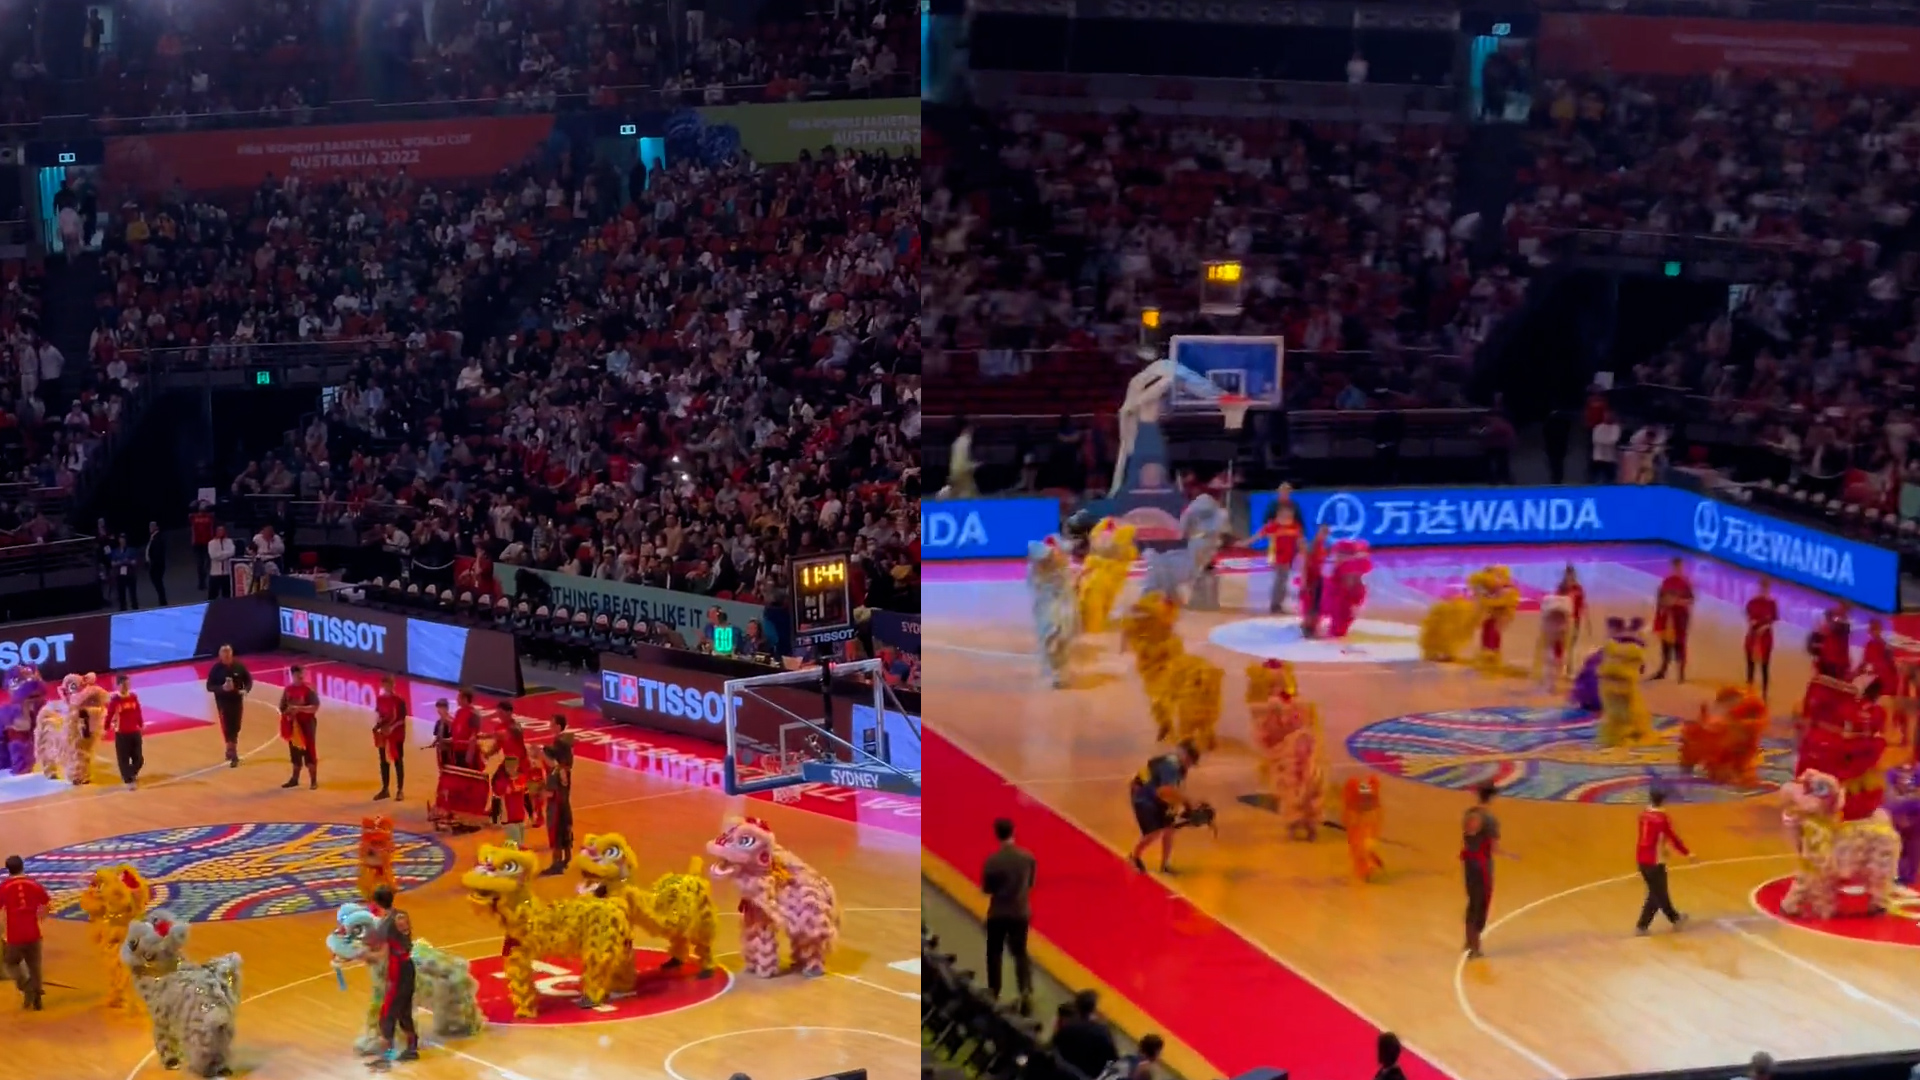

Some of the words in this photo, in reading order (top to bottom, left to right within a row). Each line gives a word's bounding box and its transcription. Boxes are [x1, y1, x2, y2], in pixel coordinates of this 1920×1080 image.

[290, 152, 378, 168] AUSTRALIA
[380, 149, 420, 164] 2022
[921, 511, 988, 548] DA
[803, 563, 844, 587] 11:44
[603, 594, 649, 619] BEATS
[653, 602, 686, 626] LIKE
[689, 608, 703, 628] IT
[309, 612, 387, 654] TISSOT
[814, 629, 855, 644] TISSOT
[830, 769, 879, 788] SYDNEY
